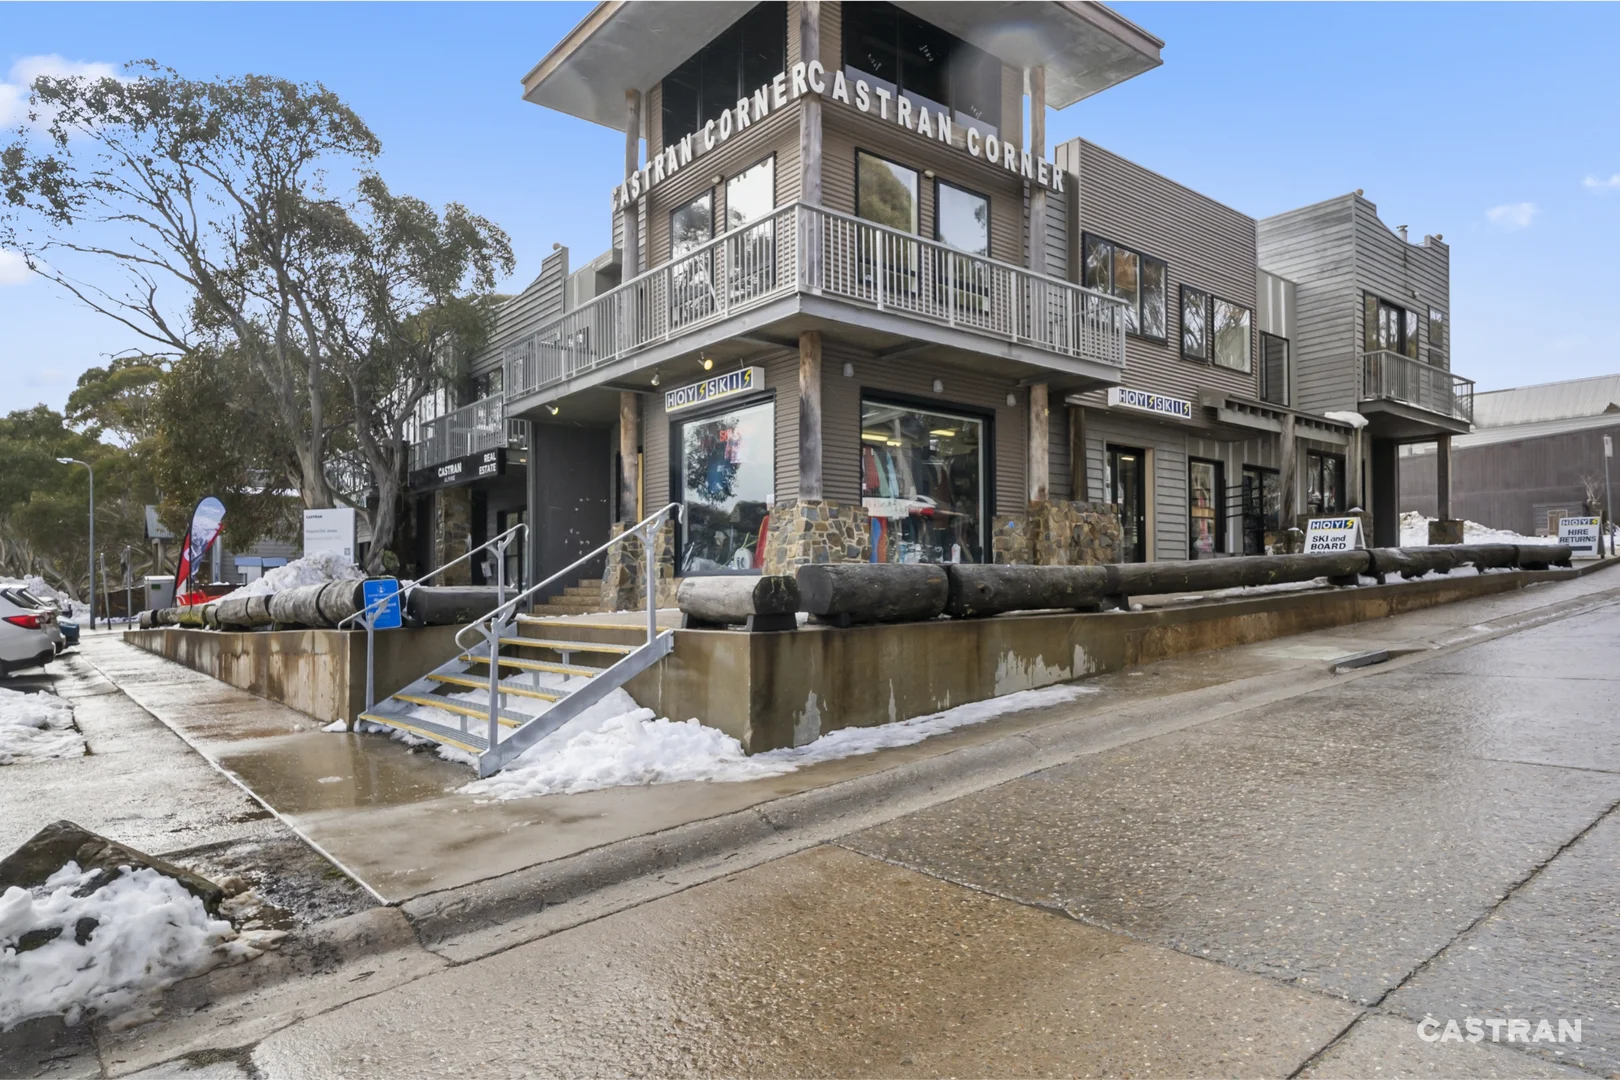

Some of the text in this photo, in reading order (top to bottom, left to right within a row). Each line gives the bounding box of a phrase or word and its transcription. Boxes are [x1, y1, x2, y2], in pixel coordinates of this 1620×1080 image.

[808, 60, 1065, 193] CASTRAN CORNER
[610, 61, 808, 213] CASTRAN CORNER
[483, 452, 496, 463] REAL
[438, 462, 462, 477] CASTRAN
[478, 463, 496, 475] ESTATE
